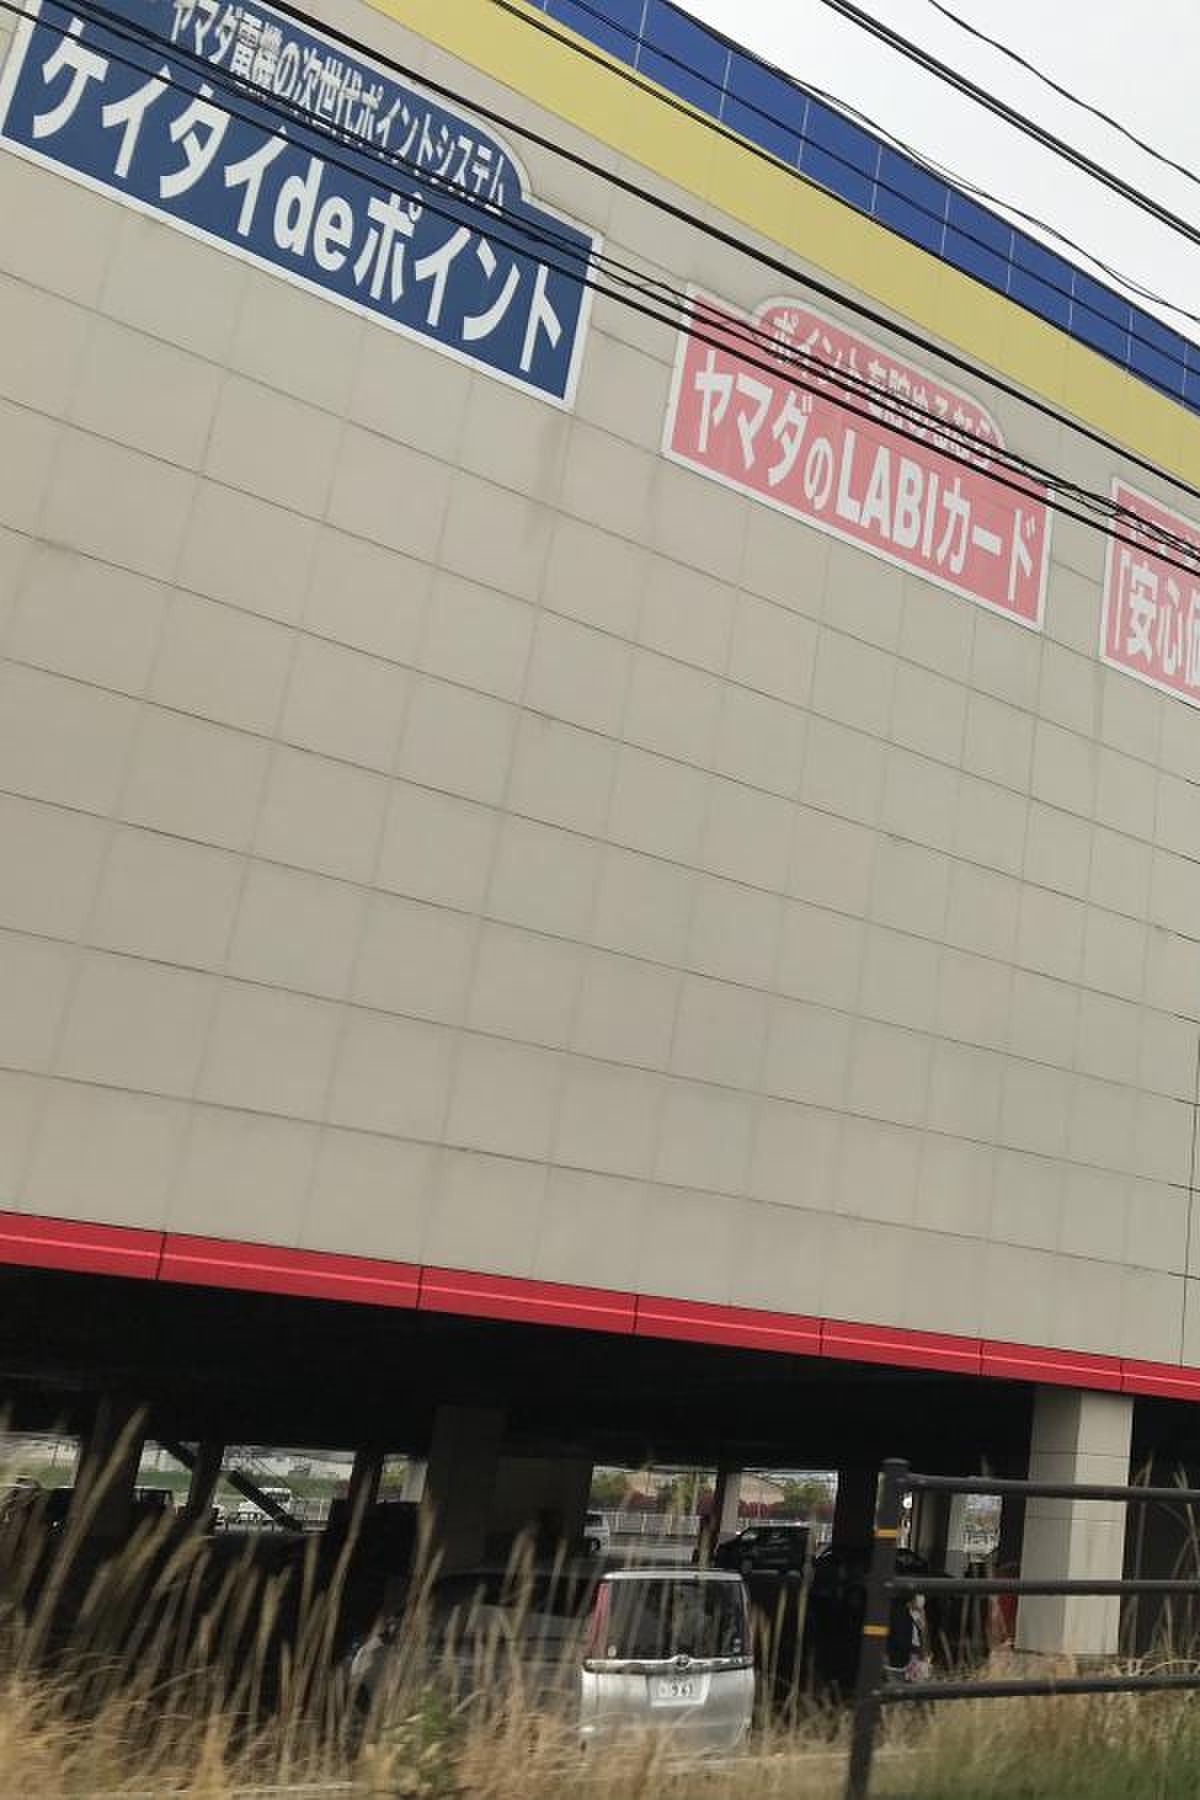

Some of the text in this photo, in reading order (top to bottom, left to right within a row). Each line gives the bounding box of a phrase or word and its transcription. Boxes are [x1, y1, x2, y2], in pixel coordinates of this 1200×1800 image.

[32, 17, 562, 373] ケイタイdeポイント
[694, 349, 1033, 602] ヤマダのLABIカード
